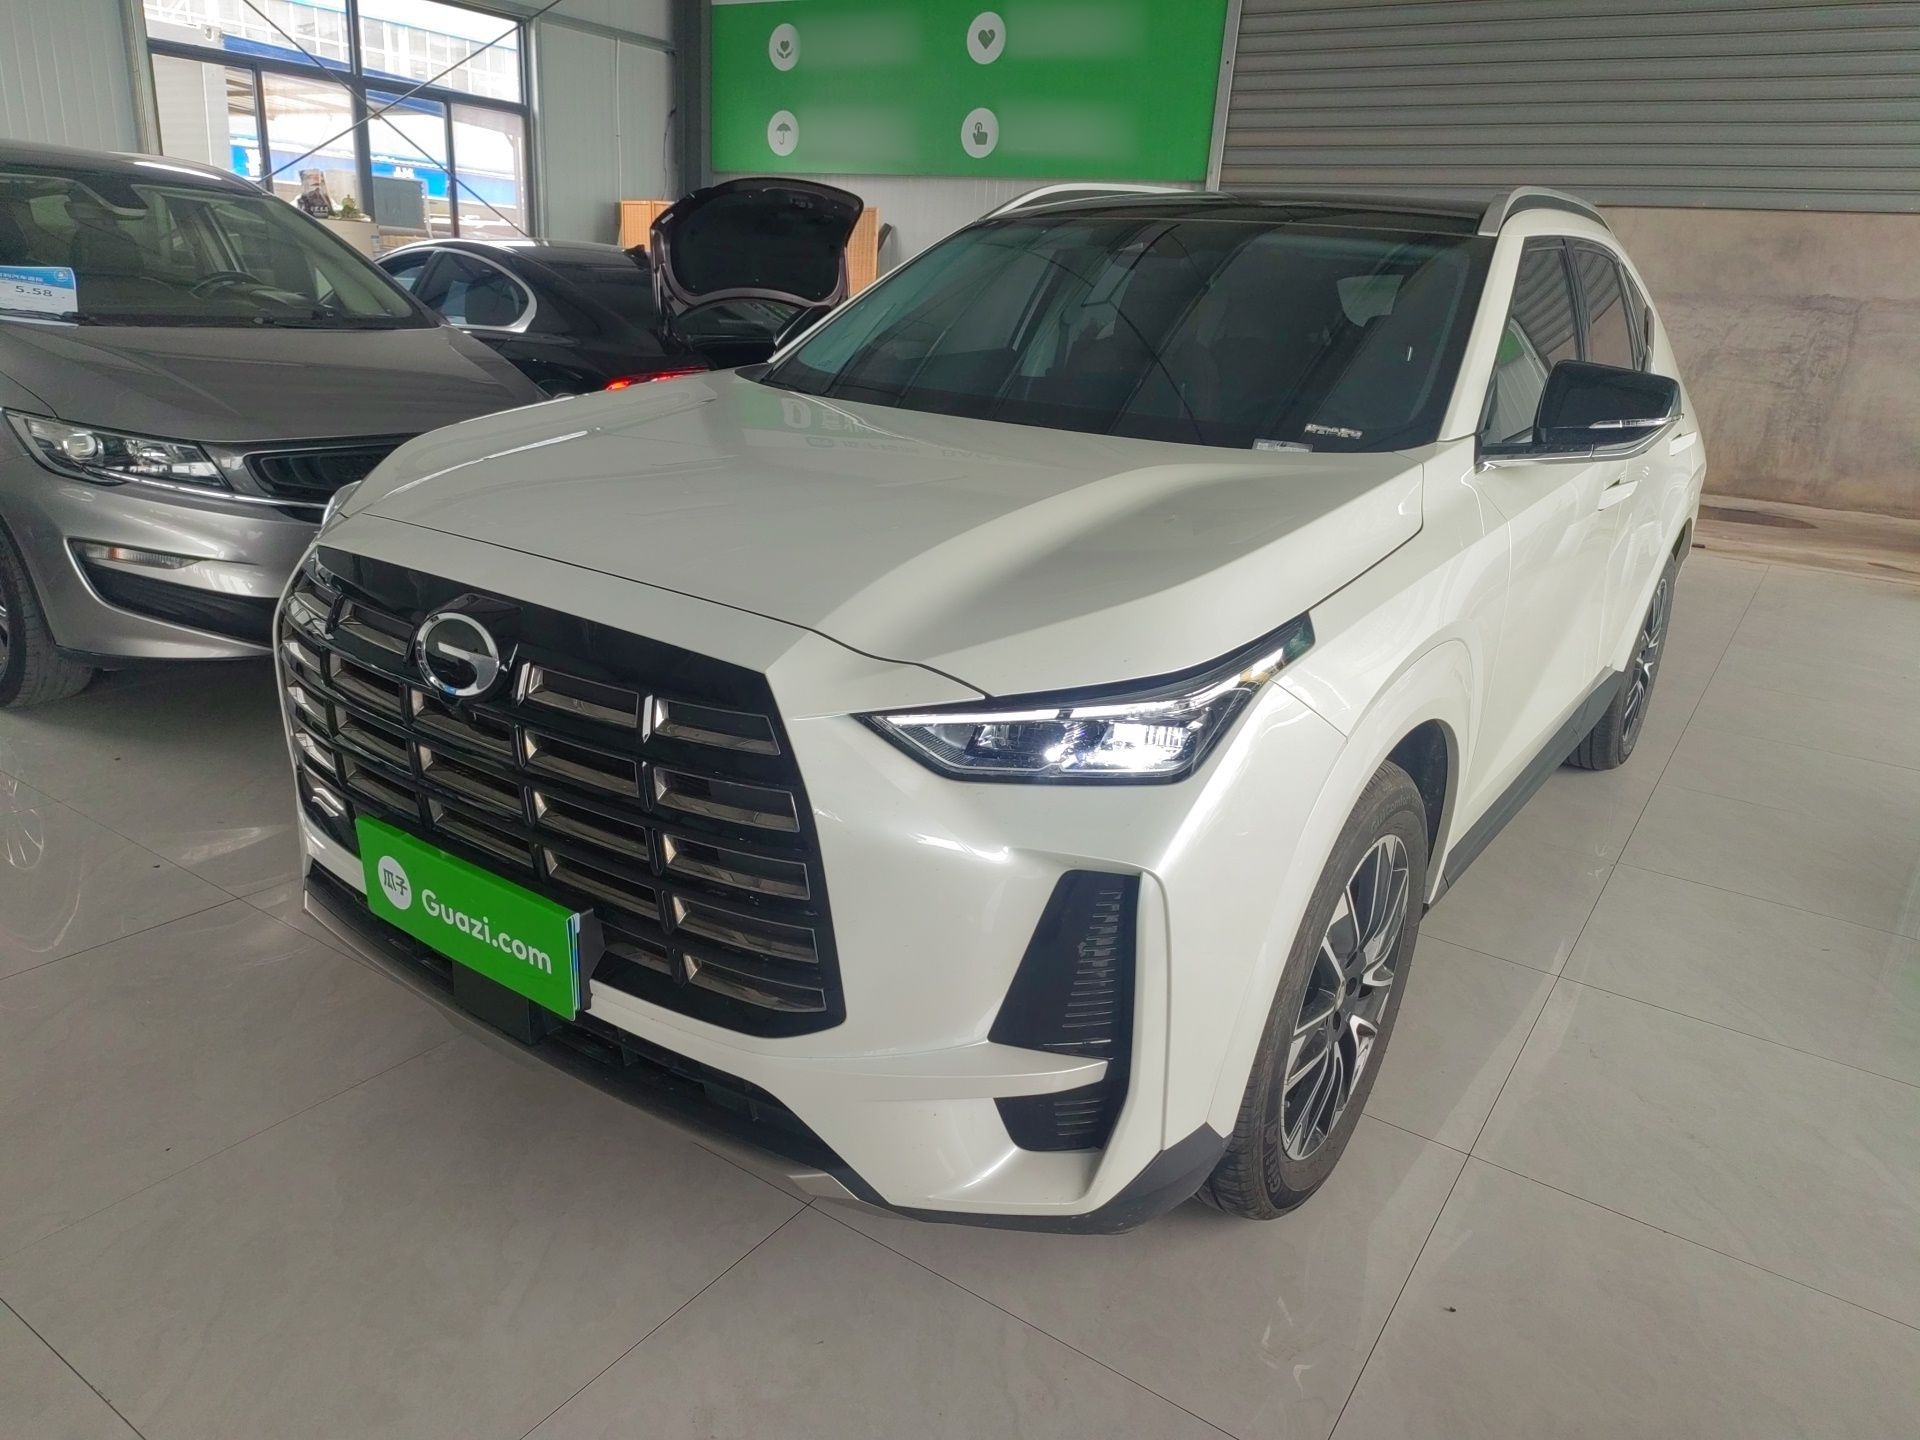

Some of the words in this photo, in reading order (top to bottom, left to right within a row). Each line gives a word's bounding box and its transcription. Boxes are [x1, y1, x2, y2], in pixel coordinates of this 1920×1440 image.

[15, 285, 53, 297] 5.58
[383, 868, 408, 896] 瓜子
[421, 889, 552, 974] Guazi.com
